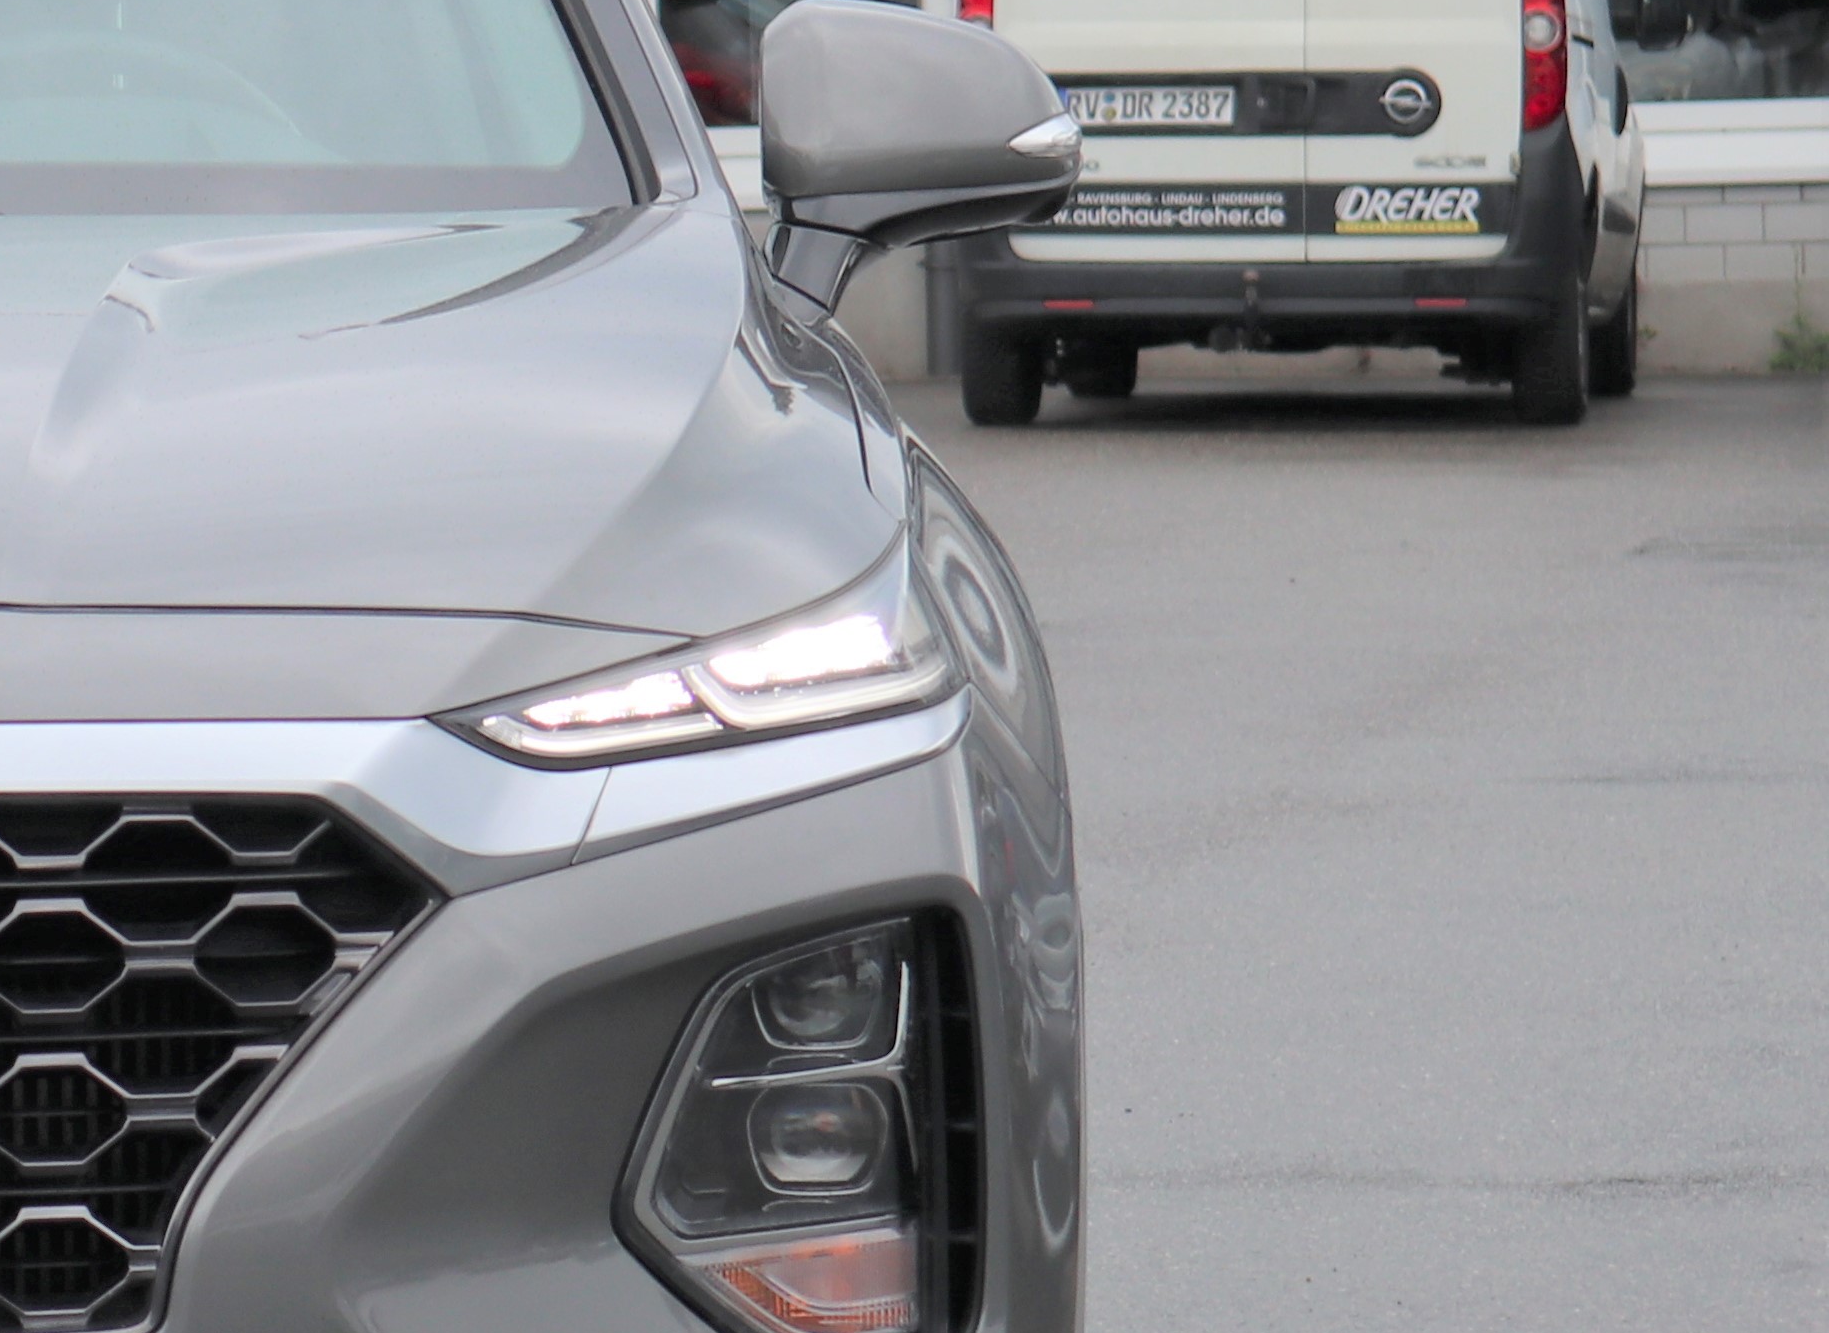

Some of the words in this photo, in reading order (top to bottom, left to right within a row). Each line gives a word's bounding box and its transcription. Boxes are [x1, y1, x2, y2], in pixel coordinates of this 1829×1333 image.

[1068, 92, 1099, 120] RV
[1121, 91, 1154, 118] DR
[1162, 90, 1230, 118] 2387
[1077, 192, 1154, 205] RAVENSBURG
[1160, 192, 1203, 205] LINDAU
[1212, 192, 1285, 205] LINDENBERG
[1335, 186, 1480, 225] DREHER
